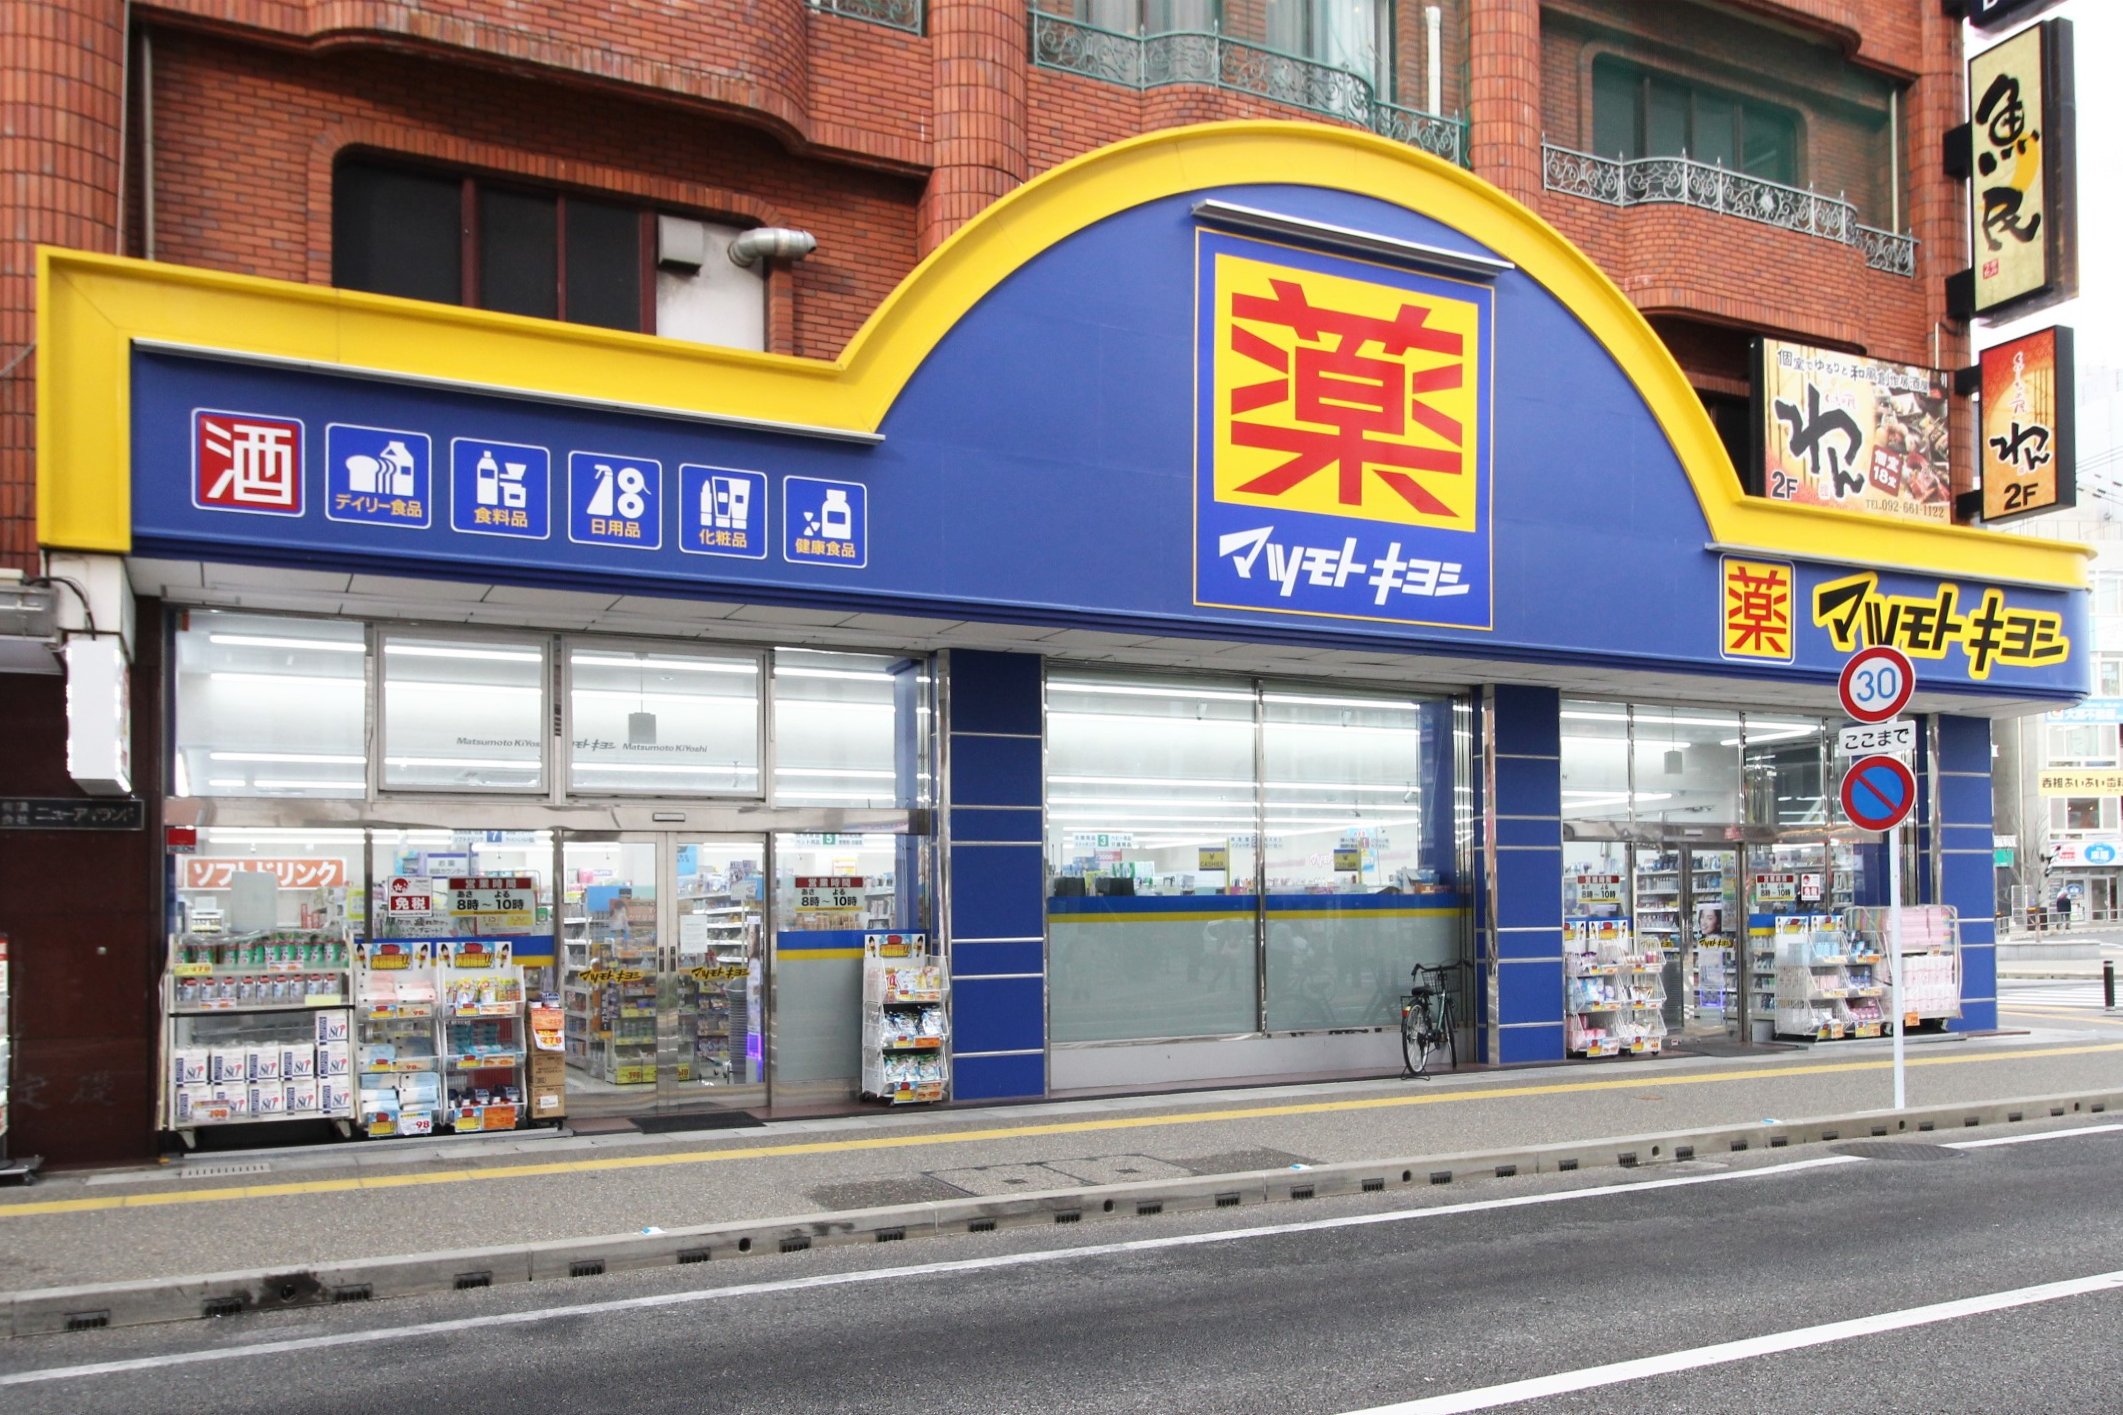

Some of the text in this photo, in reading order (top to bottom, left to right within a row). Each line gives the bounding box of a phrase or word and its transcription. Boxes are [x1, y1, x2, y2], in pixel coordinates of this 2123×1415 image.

[1231, 278, 1463, 518] 薬
[1775, 383, 1865, 497] わん
[1990, 422, 2050, 470] わん
[206, 421, 292, 505] 酒
[1772, 471, 1797, 498] 2F
[2004, 483, 2039, 511] 2F
[335, 493, 423, 518] デイリー食品
[474, 507, 529, 528] 食料品
[591, 518, 641, 538] 日用品
[699, 529, 748, 549] 化粧品
[795, 539, 856, 558] 健康食品
[1219, 525, 1470, 605] マツモトキヨシ
[1728, 566, 1787, 653] 薬
[1818, 579, 2065, 672] マツモトキヨシ
[1857, 667, 1896, 702] 30
[457, 737, 513, 747] Matsumoto
[623, 743, 708, 753] Matsumoto KiYoshi
[1845, 728, 1910, 750] ここまで
[395, 897, 426, 910] 免税
[457, 890, 511, 898] あさ よる
